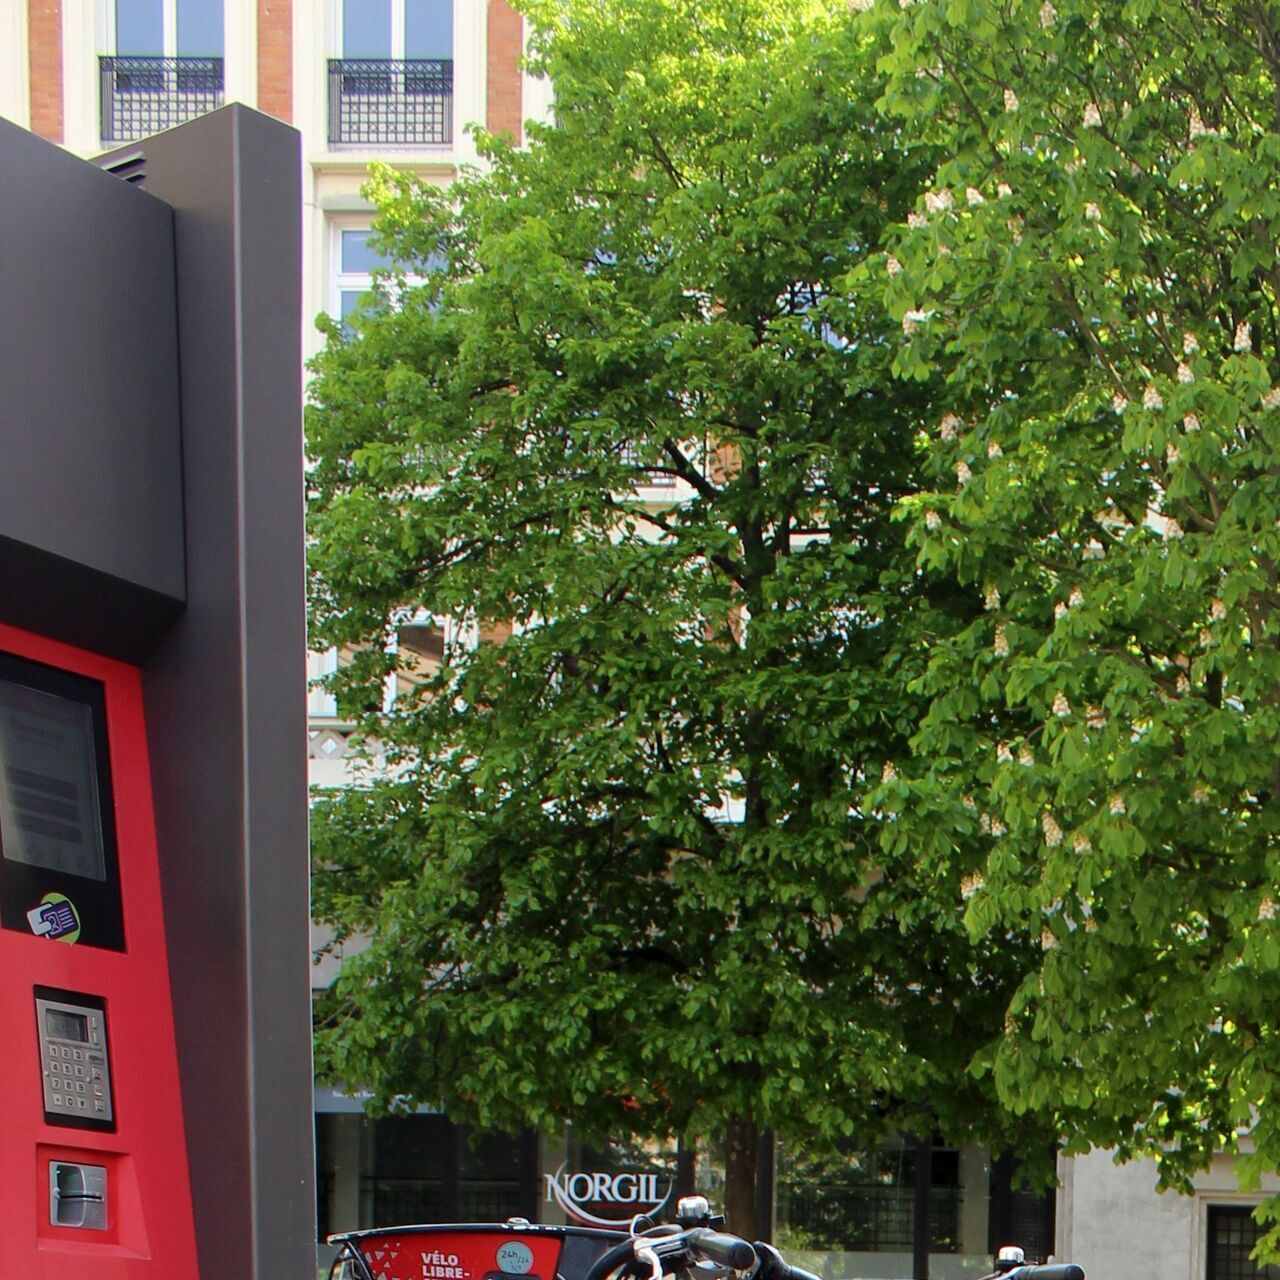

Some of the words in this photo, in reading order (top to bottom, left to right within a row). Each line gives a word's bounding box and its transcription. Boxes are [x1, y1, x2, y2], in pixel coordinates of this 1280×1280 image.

[544, 1173, 665, 1203] NORGIL
[421, 1250, 459, 1266] VÉLO
[422, 1265, 470, 1279] LIBRE-
